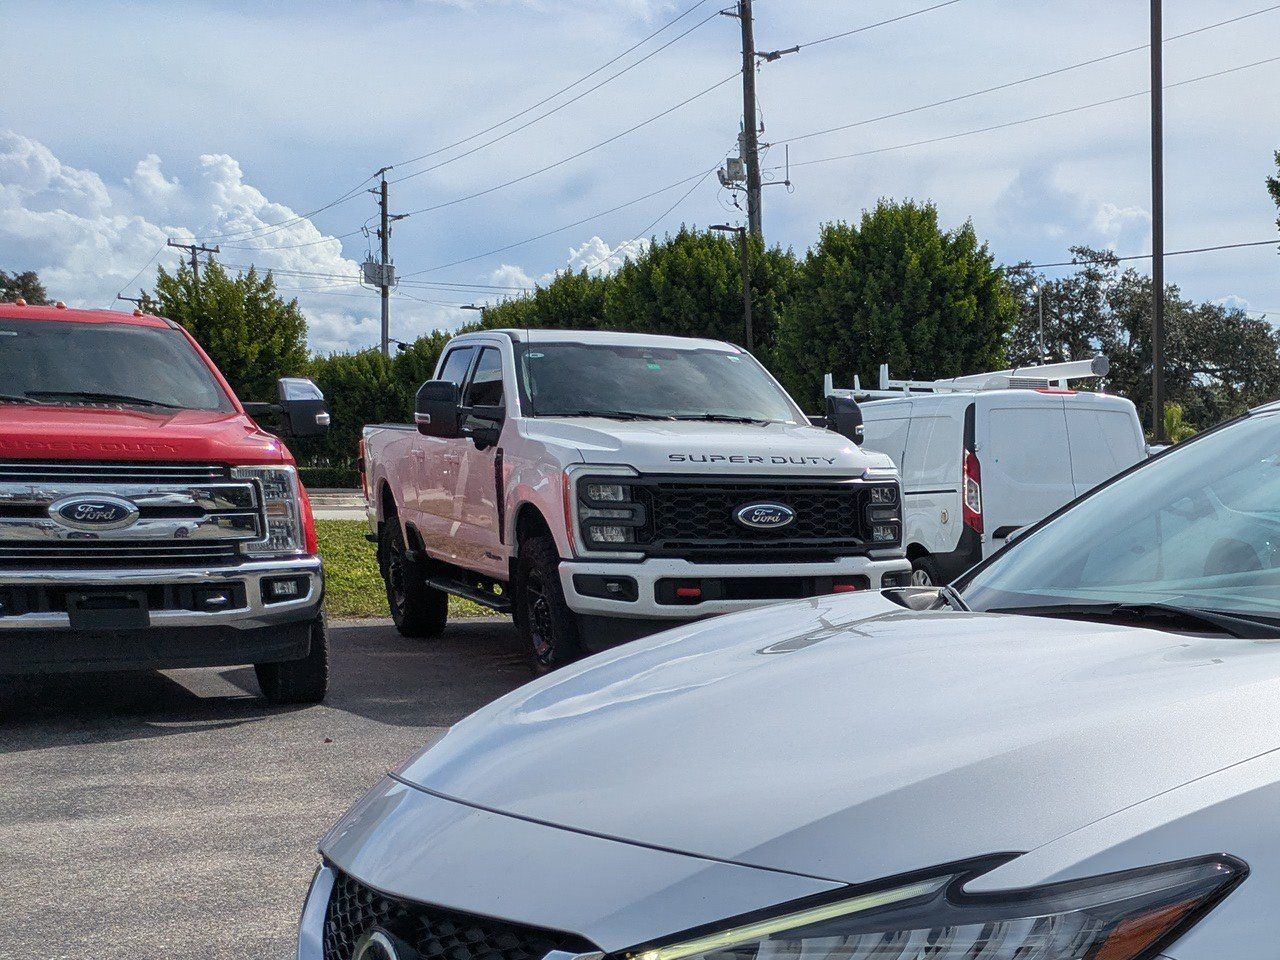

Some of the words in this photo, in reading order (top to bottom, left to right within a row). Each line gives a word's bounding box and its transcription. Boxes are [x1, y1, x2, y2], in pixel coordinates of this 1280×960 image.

[668, 453, 764, 464] SUPER
[770, 456, 836, 465] DUTY
[75, 504, 116, 520] Ford
[751, 508, 781, 523] Ford
